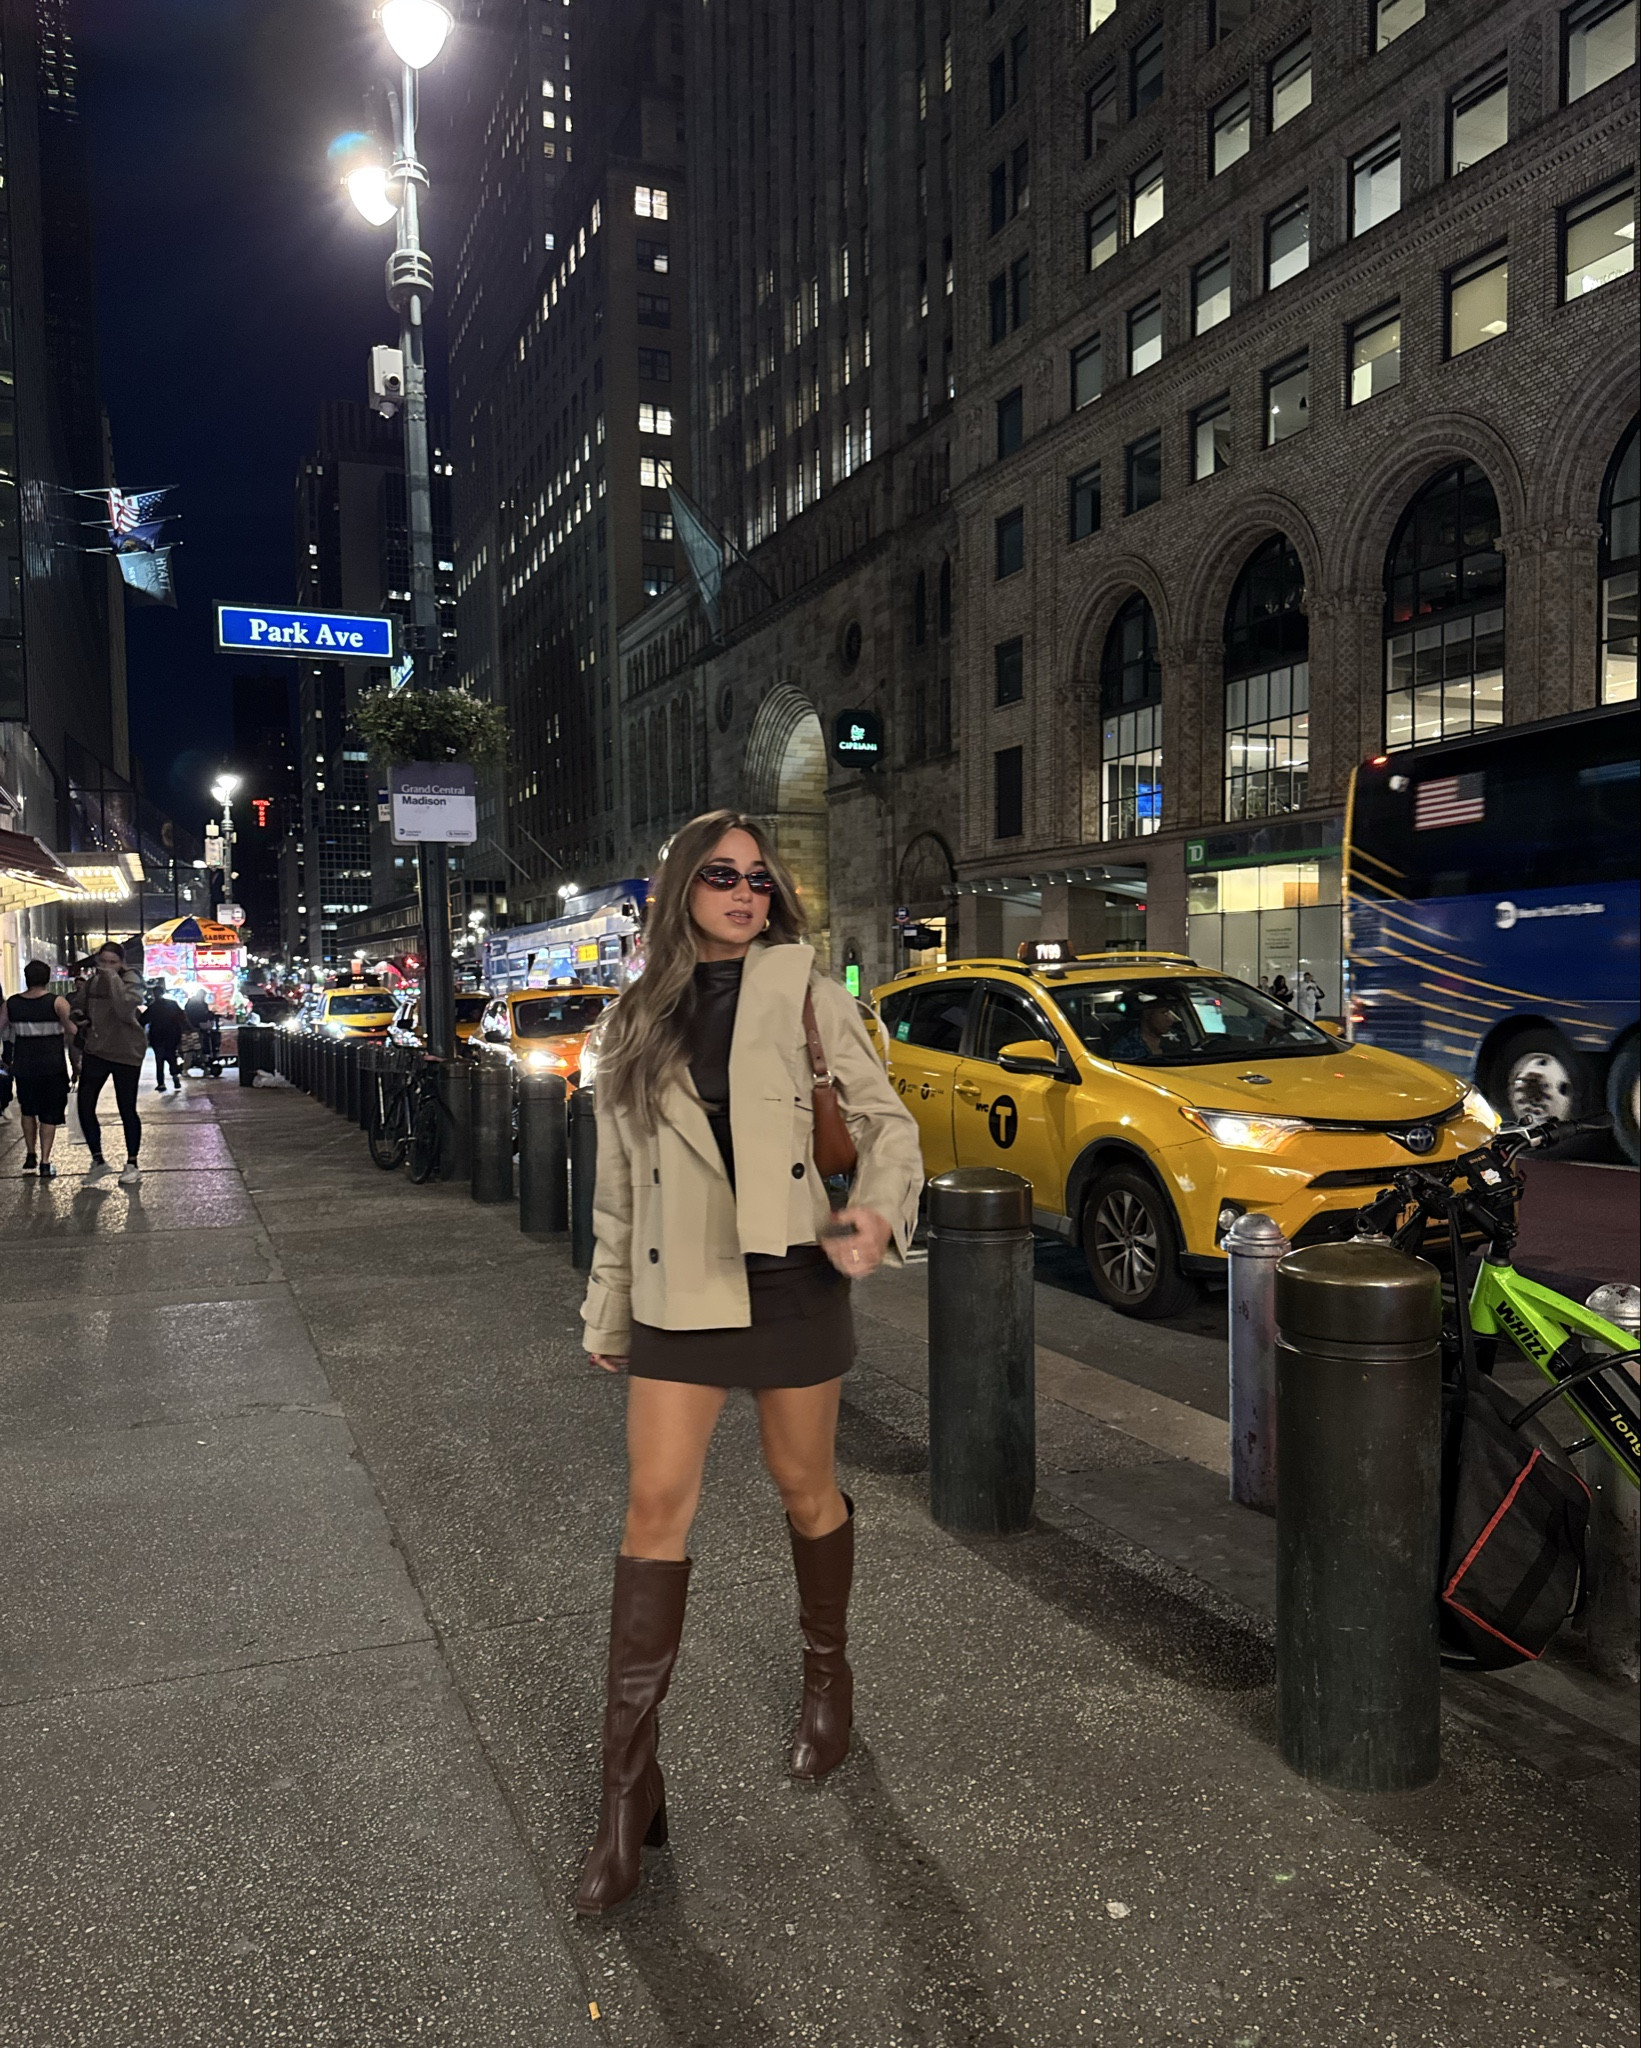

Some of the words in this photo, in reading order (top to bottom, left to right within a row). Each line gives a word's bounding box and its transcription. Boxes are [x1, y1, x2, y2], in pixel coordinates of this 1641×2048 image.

[155, 557, 172, 593] HYATT
[249, 618, 309, 645] Park
[315, 623, 364, 648] Ave
[838, 741, 878, 751] CIPRIANI
[401, 783, 431, 794] Grand
[431, 785, 466, 795] Central
[402, 796, 447, 806] Madison
[1188, 844, 1204, 862] TD
[975, 1102, 990, 1113] NYC
